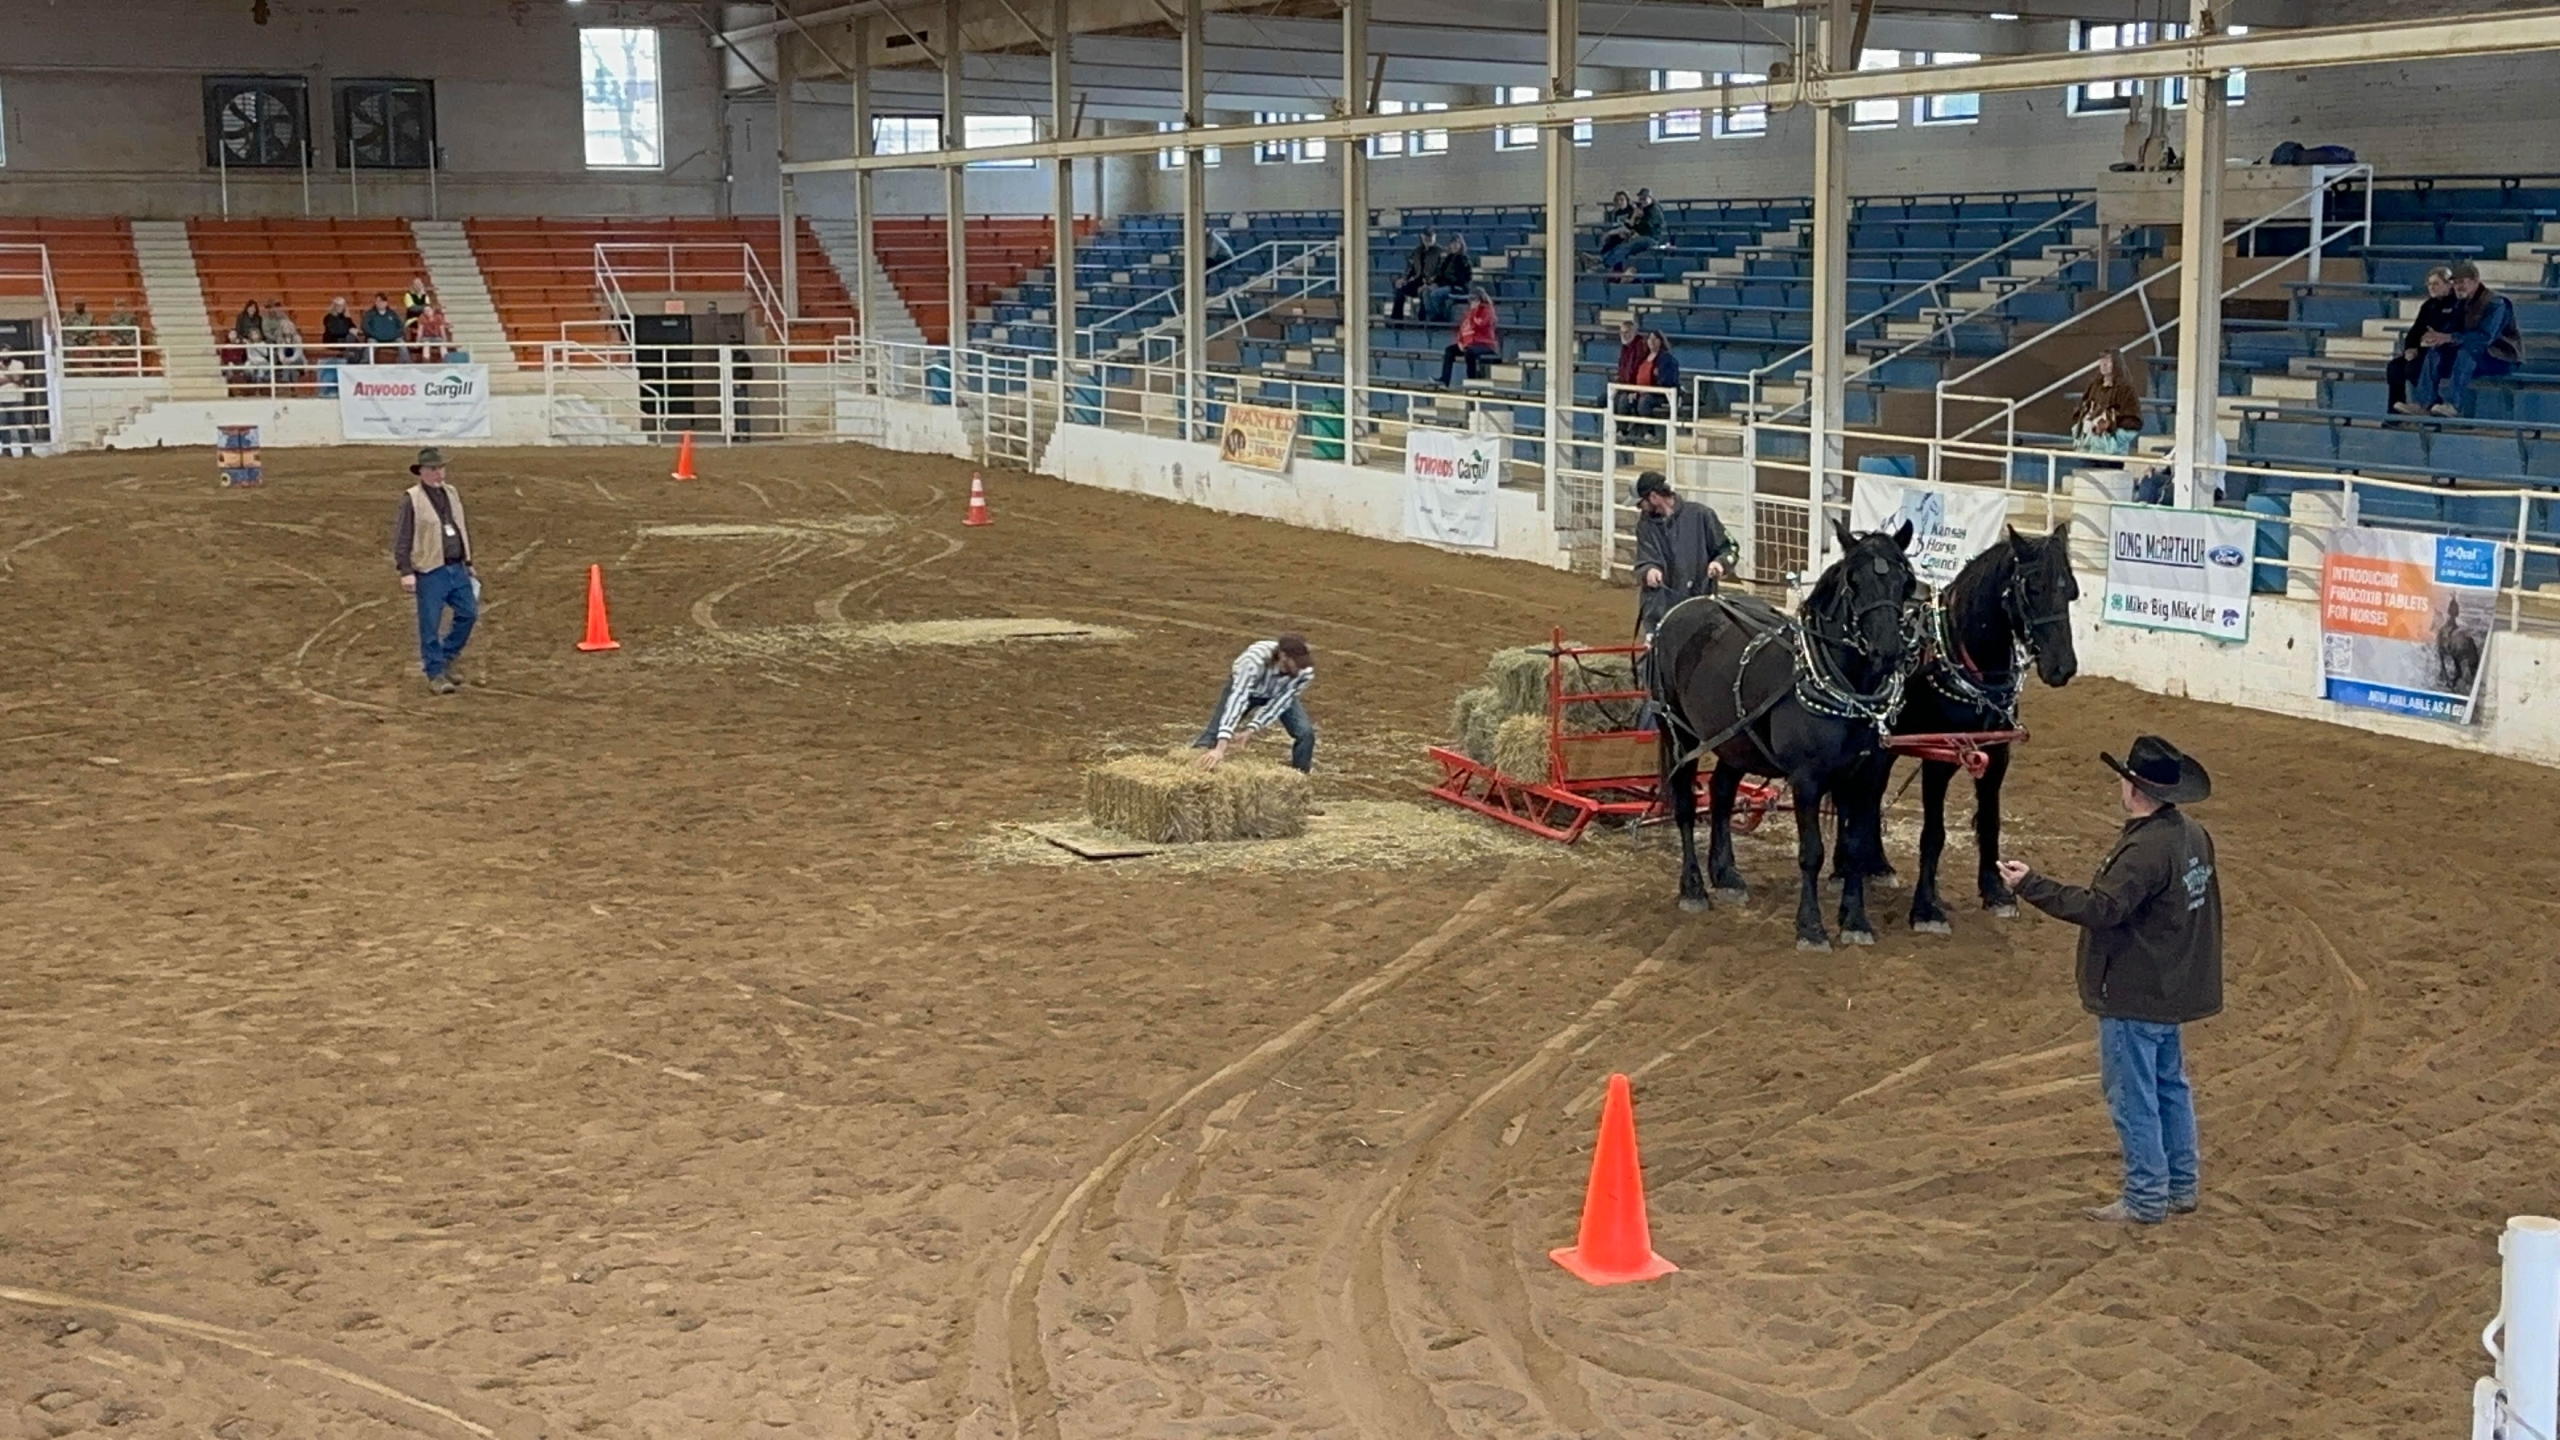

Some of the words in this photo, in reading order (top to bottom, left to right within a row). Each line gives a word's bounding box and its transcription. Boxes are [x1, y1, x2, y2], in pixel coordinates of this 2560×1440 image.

[425, 381, 473, 399] Cargill
[1230, 408, 1296, 431] WANTED
[1457, 457, 1490, 484] Cargill
[1926, 538, 1957, 555] Horse
[2115, 530, 2141, 556] LONG
[2332, 566, 2399, 588] INTRODUCING
[2125, 595, 2148, 614] Mike
[2329, 585, 2383, 606] FIROCOXIB
[2384, 593, 2429, 612] TABLETS
[2327, 604, 2349, 620] FOR
[2350, 608, 2388, 626] HORSES
[2368, 690, 2388, 703] NOW
[2388, 694, 2431, 711] AVAILABLE
[2431, 700, 2444, 713] AS
[2444, 702, 2451, 714] A
